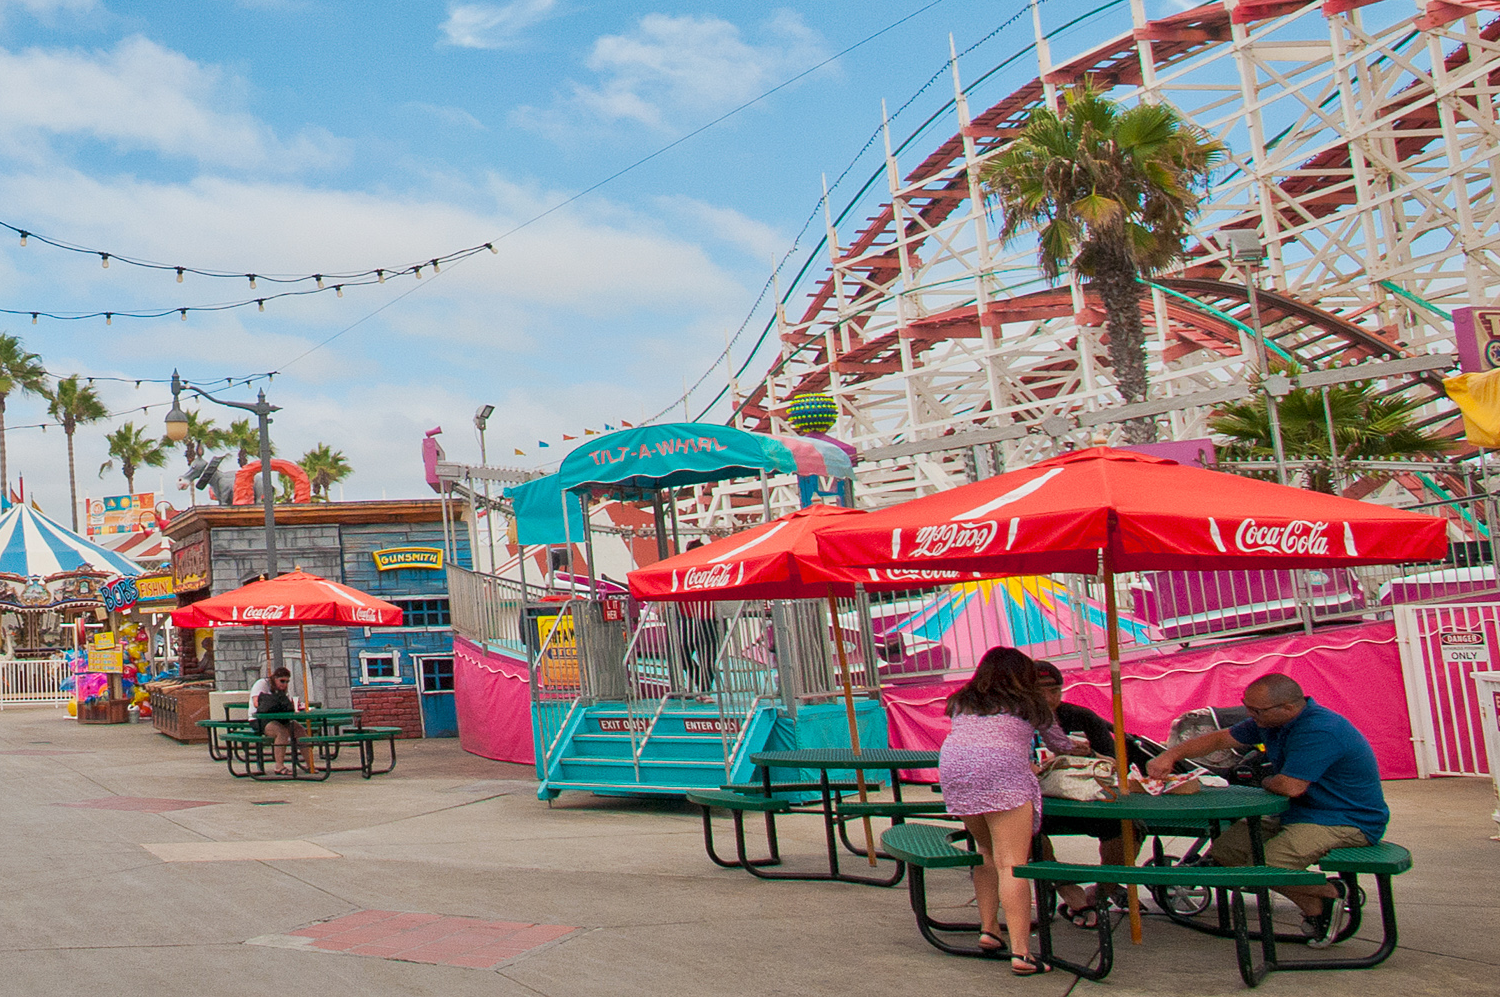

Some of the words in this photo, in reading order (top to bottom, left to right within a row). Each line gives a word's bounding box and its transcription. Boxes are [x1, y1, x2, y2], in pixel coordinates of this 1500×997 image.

[588, 437, 728, 465] TILT-A-WHIRL
[908, 520, 998, 557] Coca-Cola
[1235, 518, 1329, 554] Coca-Cola
[381, 553, 437, 564] GUNSMITH
[684, 563, 734, 590] Coca-Cola
[100, 578, 139, 612] BOBS
[242, 605, 285, 619] Coca-Cola
[1451, 652, 1477, 660] ONLY
[600, 719, 620, 729] EXIT
[685, 721, 713, 731] ENTER
